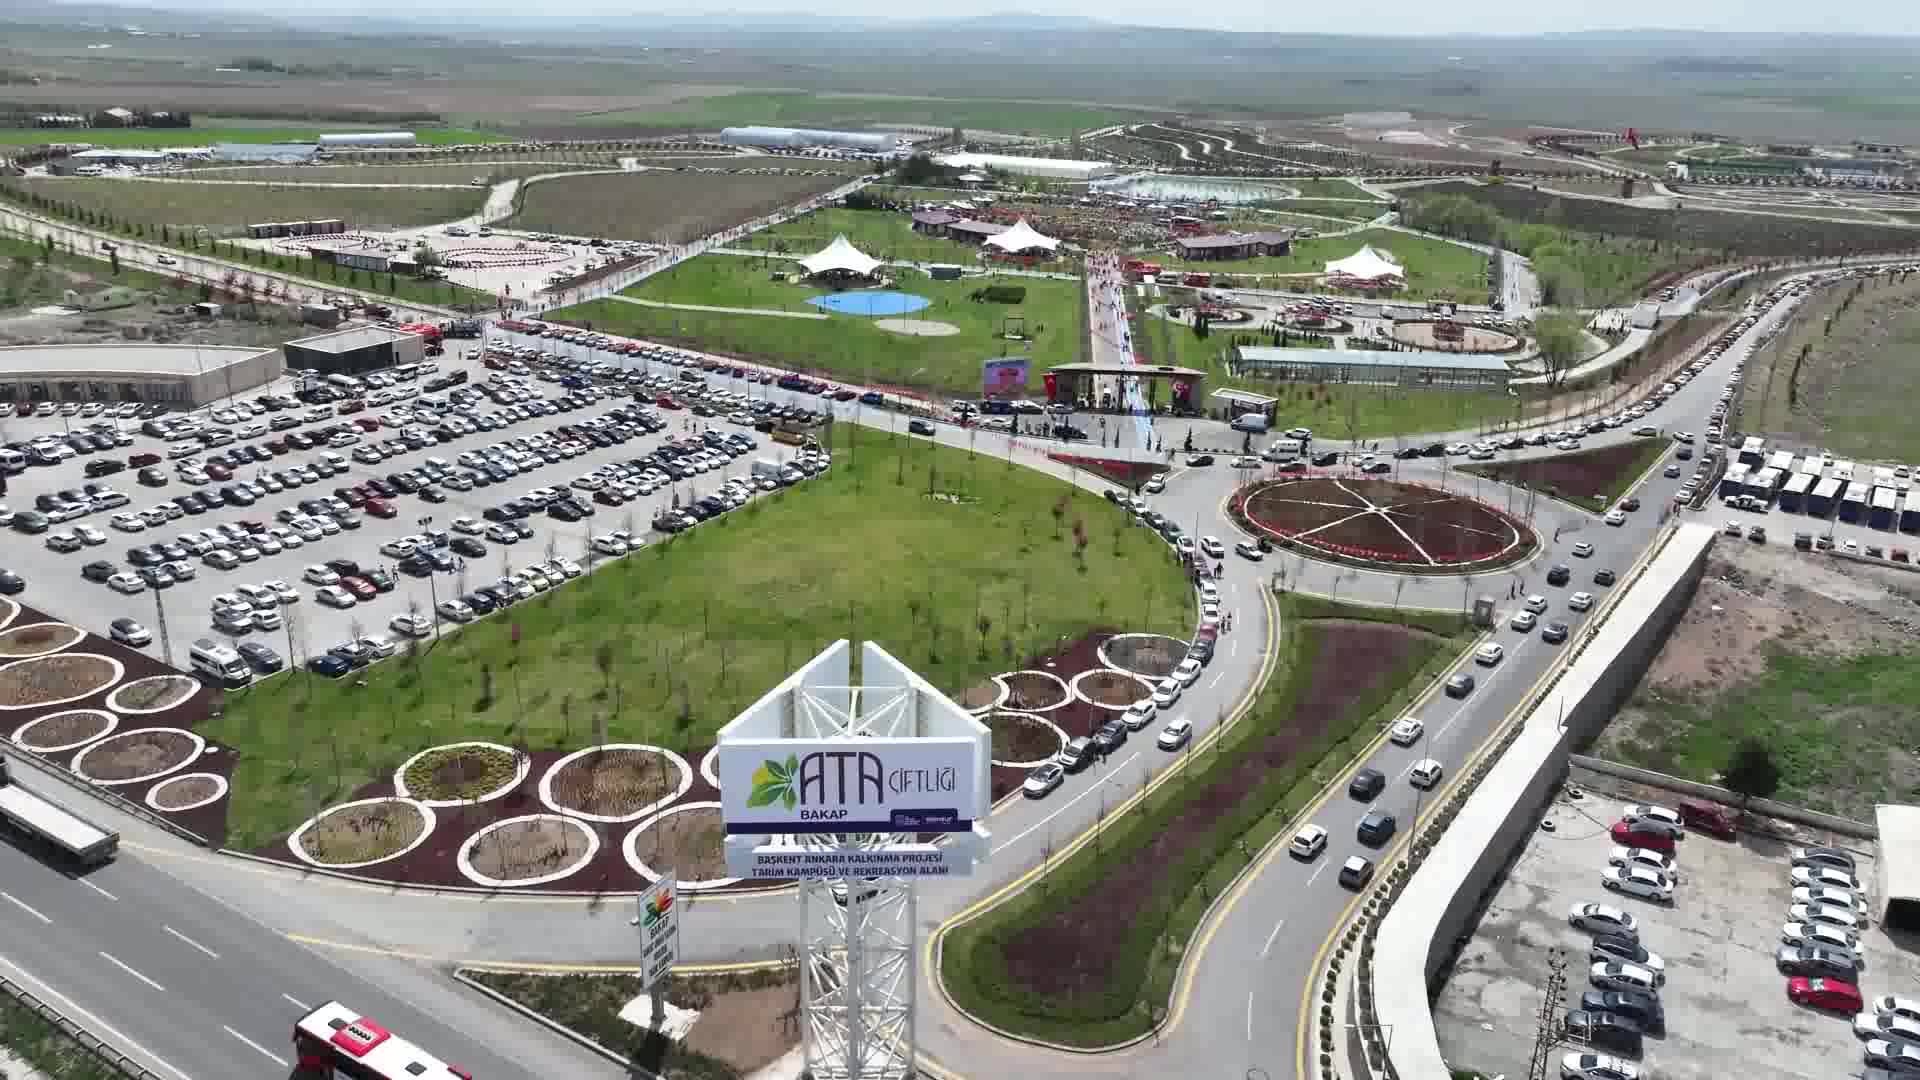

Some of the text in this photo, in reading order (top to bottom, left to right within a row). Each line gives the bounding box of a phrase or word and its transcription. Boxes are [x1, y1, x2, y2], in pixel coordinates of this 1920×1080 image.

[800, 752, 956, 805] ATA ÇİFTLİĞİ
[800, 809, 848, 820] BAKAP
[757, 852, 943, 866] BAŞKENT ANKARA KALKINMA PROJESİ
[752, 865, 949, 877] TARIM KAMPÜSÜ VE REKREASYON ALANI
